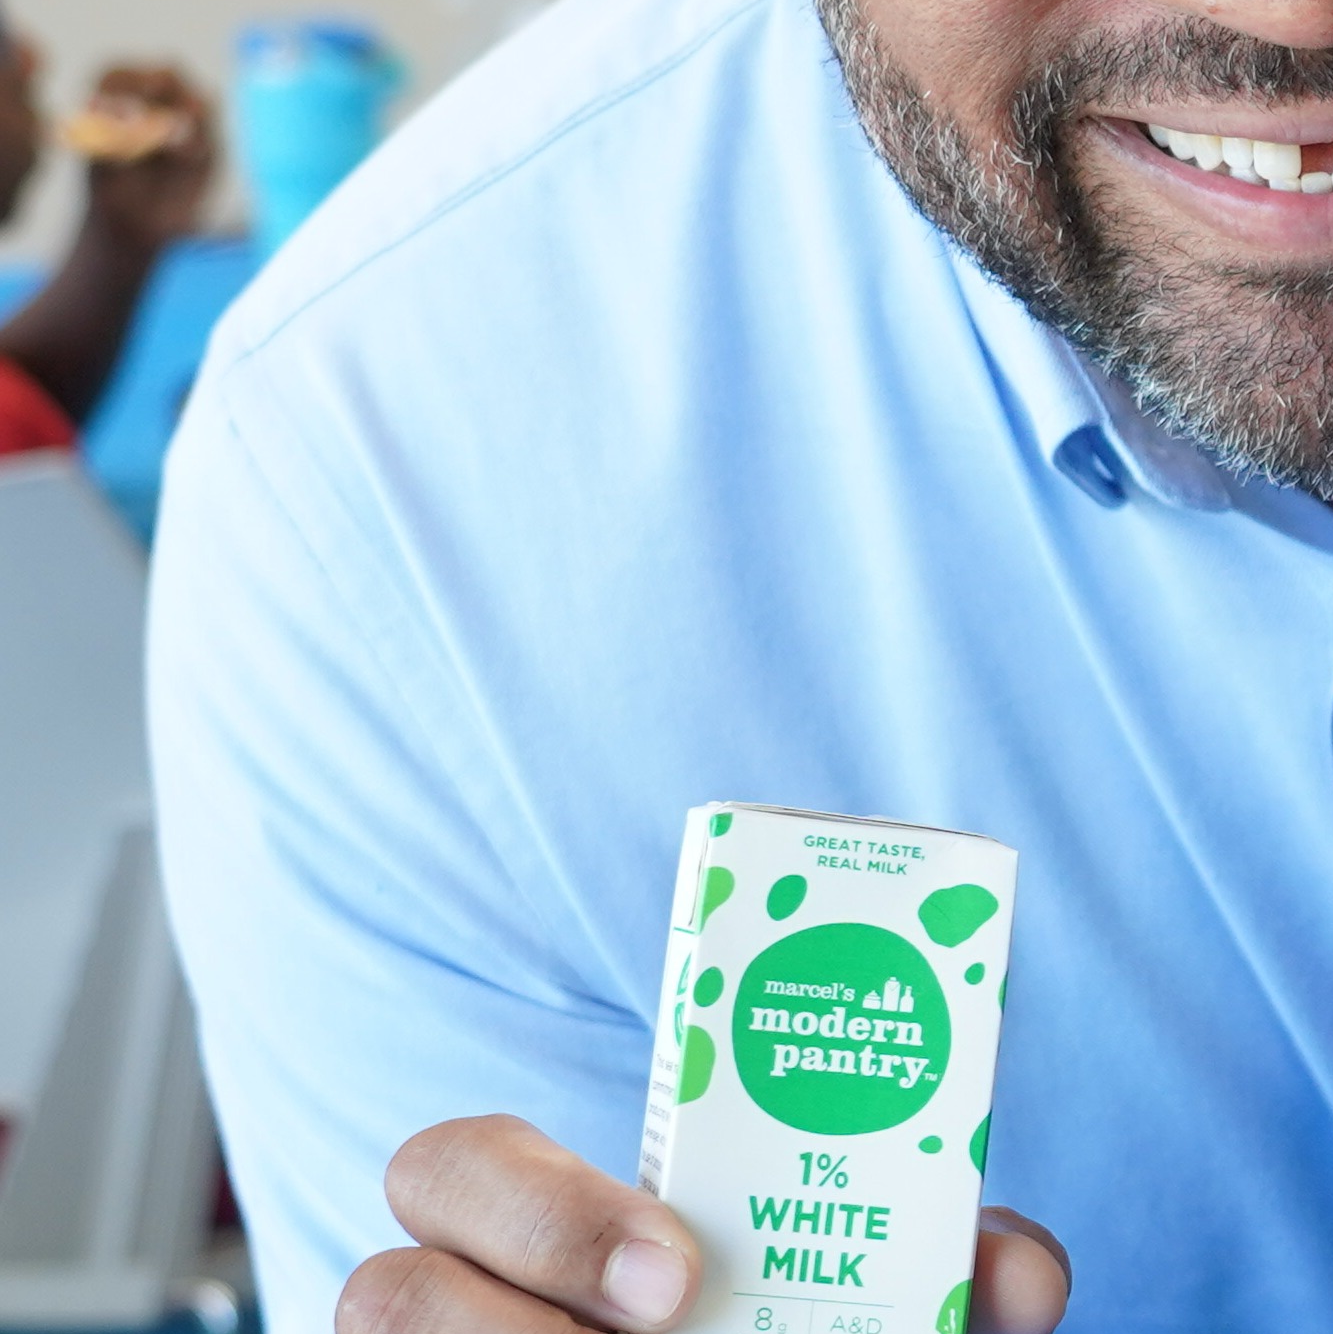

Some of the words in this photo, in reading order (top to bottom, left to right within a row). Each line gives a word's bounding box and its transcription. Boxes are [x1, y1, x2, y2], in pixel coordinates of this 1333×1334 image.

[803, 835, 862, 852] GREAT
[868, 842, 925, 860] TASTE,
[817, 855, 862, 871] REAL
[867, 860, 908, 875] MILK
[764, 980, 856, 1001] marcel's
[749, 1006, 924, 1046] modern
[799, 1152, 849, 1189] 1%
[749, 1195, 891, 1240] WHITE
[763, 1246, 867, 1287] MILK
[755, 1307, 773, 1331] 8
[777, 1323, 788, 1334] g
